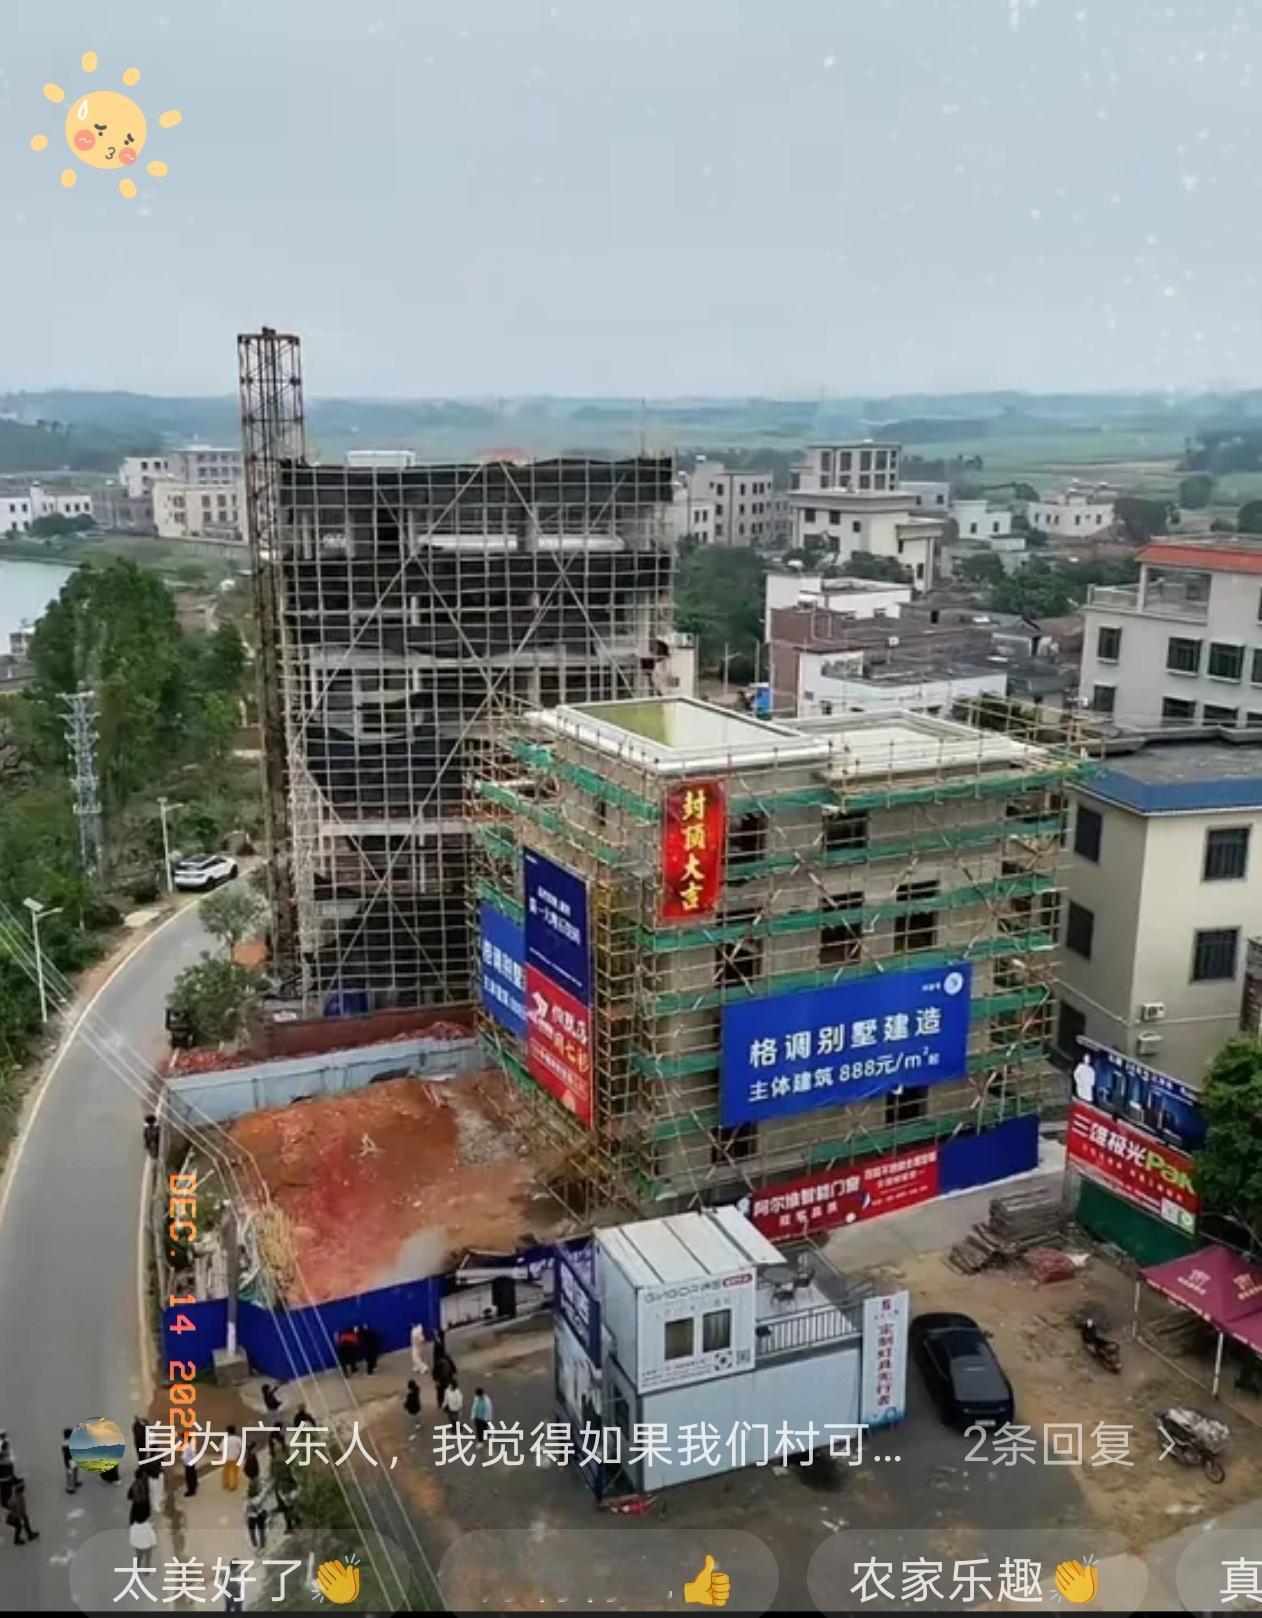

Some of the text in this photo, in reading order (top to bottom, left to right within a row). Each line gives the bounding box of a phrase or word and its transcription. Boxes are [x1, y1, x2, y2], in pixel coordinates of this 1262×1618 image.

[679, 787, 707, 911] 封顶大吉
[749, 1006, 942, 1069] 格调别墅建造
